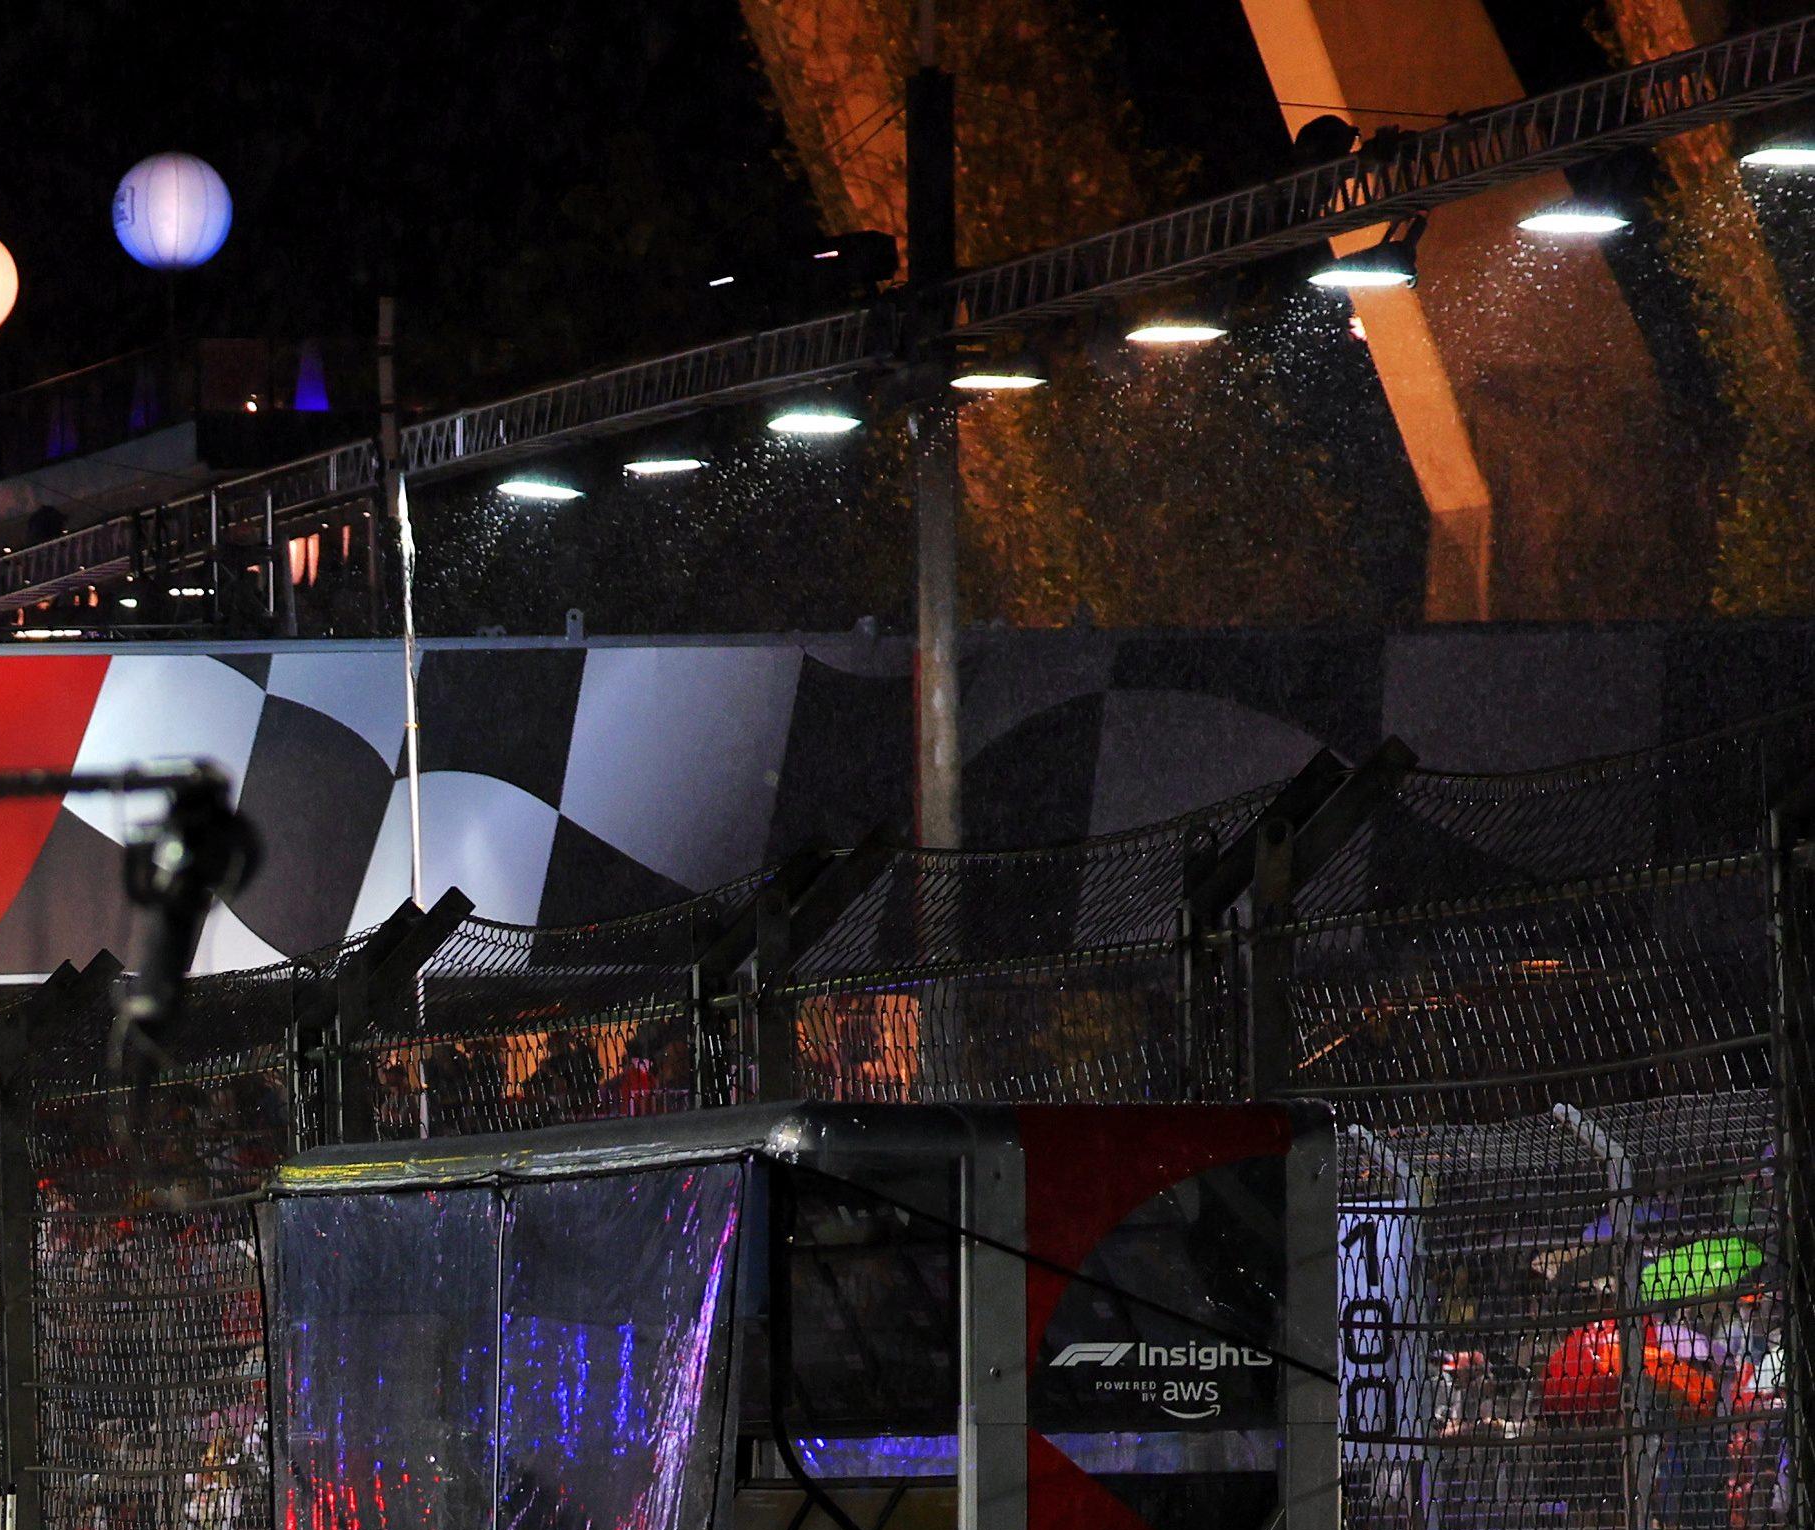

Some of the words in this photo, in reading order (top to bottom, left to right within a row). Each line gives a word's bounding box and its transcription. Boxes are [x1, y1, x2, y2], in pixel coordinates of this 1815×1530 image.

[1139, 1340, 1273, 1371] Insights
[1095, 1380, 1157, 1391] POWERED
[1162, 1380, 1219, 1402] aws
[1141, 1392, 1157, 1402] BY
